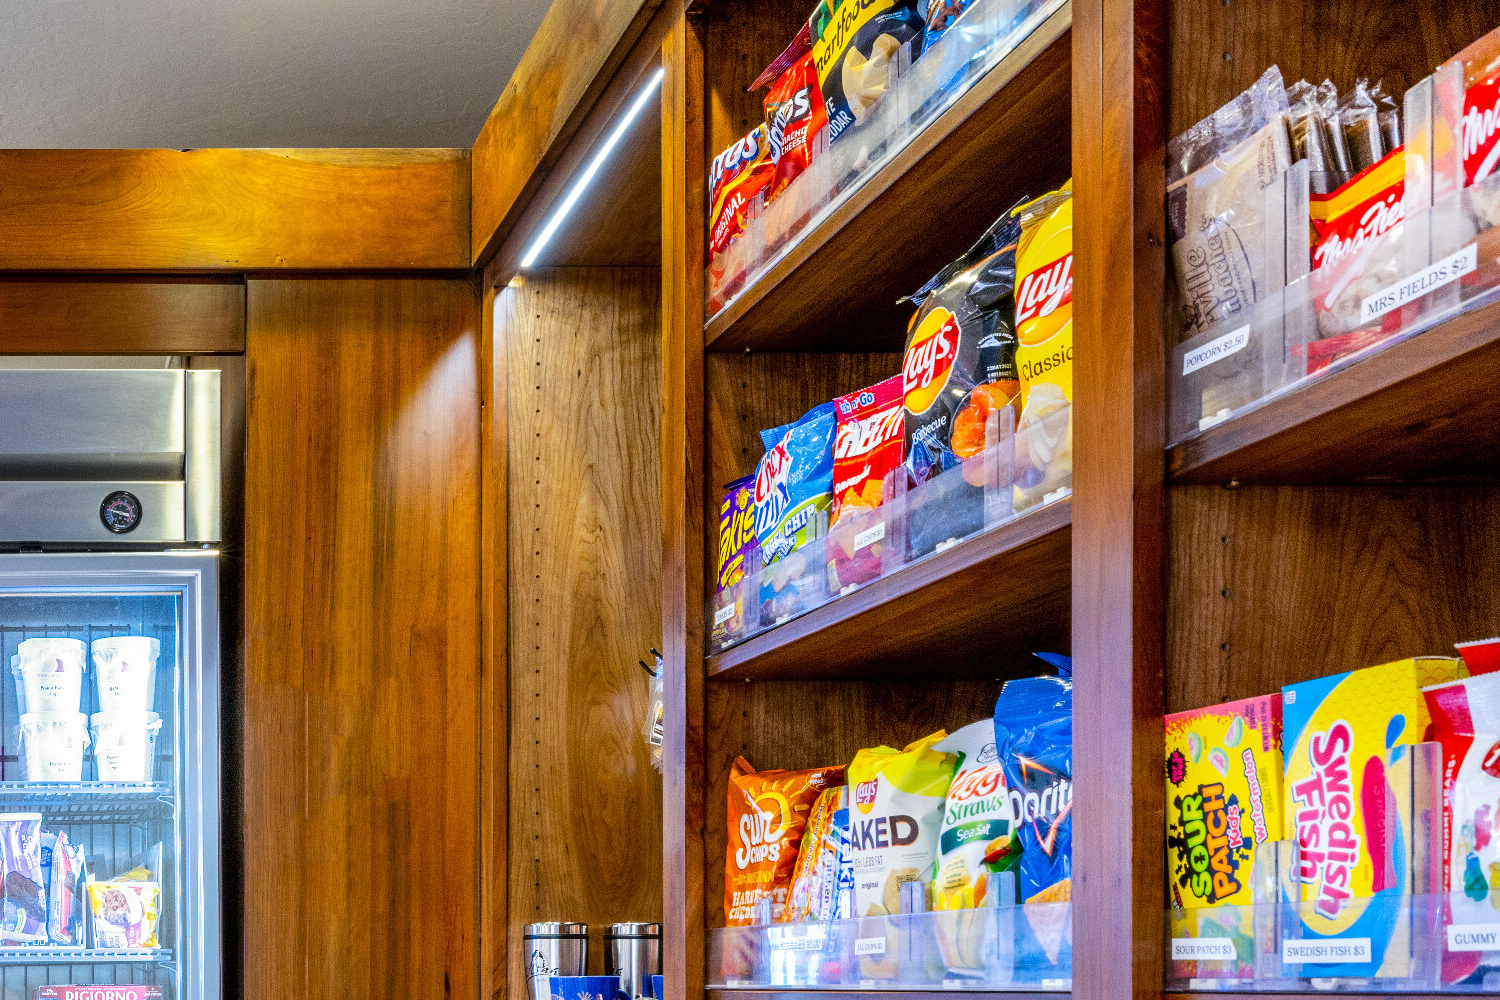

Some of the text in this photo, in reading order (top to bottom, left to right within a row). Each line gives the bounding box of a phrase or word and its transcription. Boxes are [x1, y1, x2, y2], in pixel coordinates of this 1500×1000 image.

[781, 135, 807, 156] CHEESE
[782, 126, 807, 146] NACHO
[715, 192, 746, 243] ORIGINAL
[1367, 256, 1468, 316] MRS FIELDS $2
[904, 321, 954, 388] Lay's
[1186, 334, 1245, 369] POPCORN $2.50
[860, 392, 874, 404] Go
[911, 415, 947, 444] Barbecue
[785, 504, 816, 537] CHIP
[856, 778, 878, 805] Lay's
[1242, 748, 1267, 843] Watermelon
[946, 796, 1003, 825] Straws
[1227, 803, 1243, 848] Kids
[1292, 772, 1327, 881] Fish
[1313, 720, 1360, 918] Swedish
[736, 811, 775, 870] Sun
[851, 815, 919, 850] AKED
[956, 828, 974, 842] Sea
[1182, 793, 1212, 898] SOUR
[1202, 782, 1241, 901] PATCH
[750, 841, 780, 866] CHIPS
[861, 880, 879, 889] original
[1175, 945, 1195, 956] SOUR
[1196, 945, 1220, 956] PATCH
[1287, 945, 1365, 958] SWEDISH FISH $3
[1454, 932, 1496, 946] GUMMY
